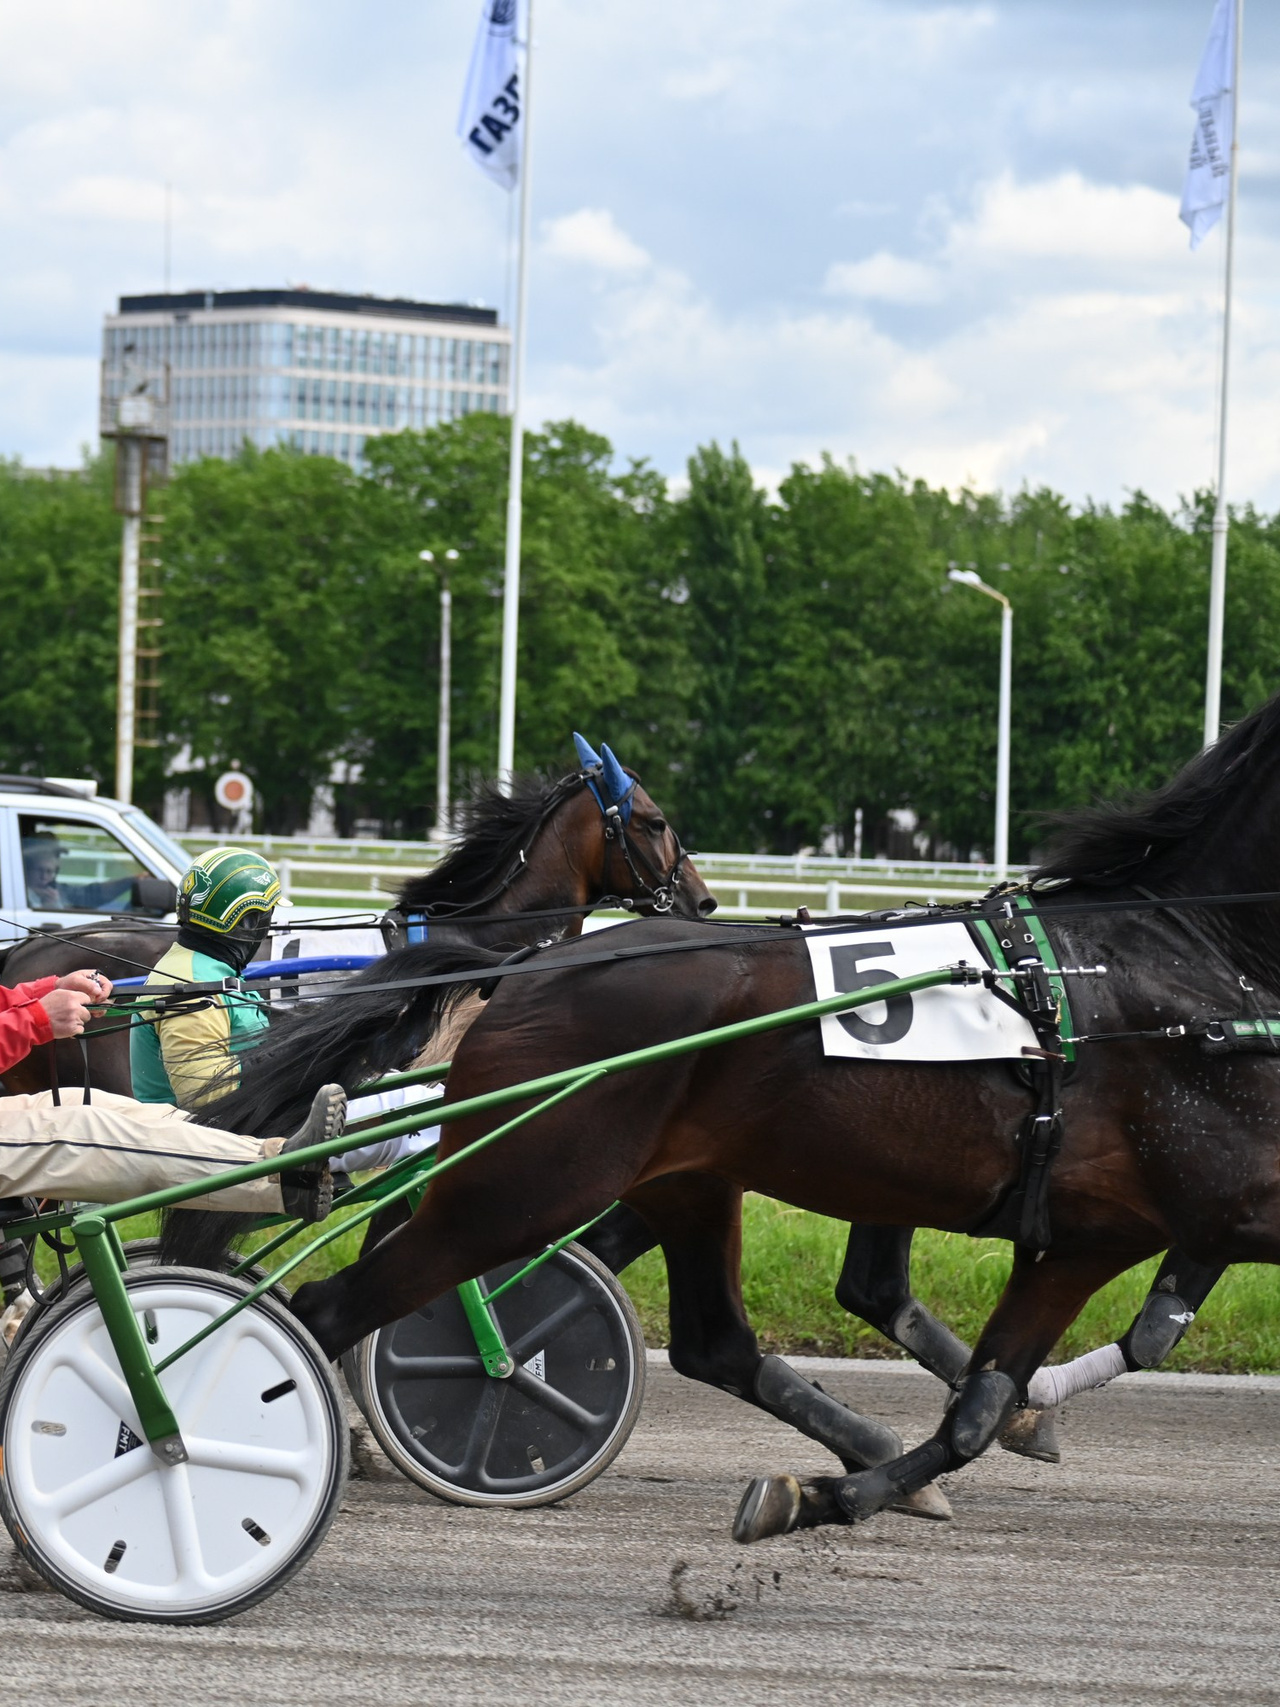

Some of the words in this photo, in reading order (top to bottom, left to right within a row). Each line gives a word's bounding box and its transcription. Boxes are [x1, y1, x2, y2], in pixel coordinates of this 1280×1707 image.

[829, 941, 914, 1045] 5
[535, 1356, 543, 1378] FMT
[118, 1425, 131, 1453] FMT
